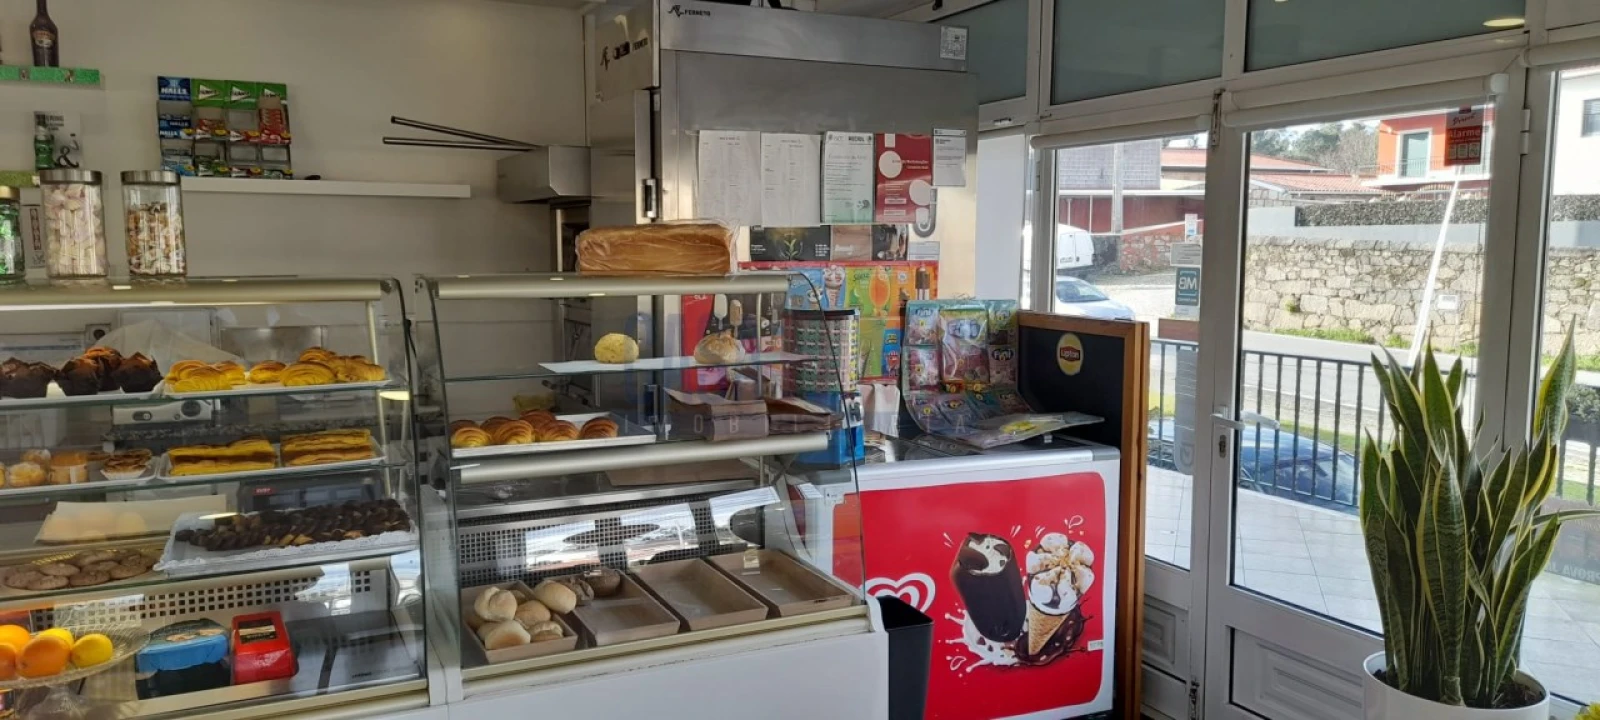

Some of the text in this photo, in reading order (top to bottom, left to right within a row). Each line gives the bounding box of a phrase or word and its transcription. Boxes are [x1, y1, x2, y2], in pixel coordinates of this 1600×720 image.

[160, 87, 188, 95] HALLS
[1448, 129, 1481, 139] Alarme
[1061, 349, 1080, 360] Lipton
